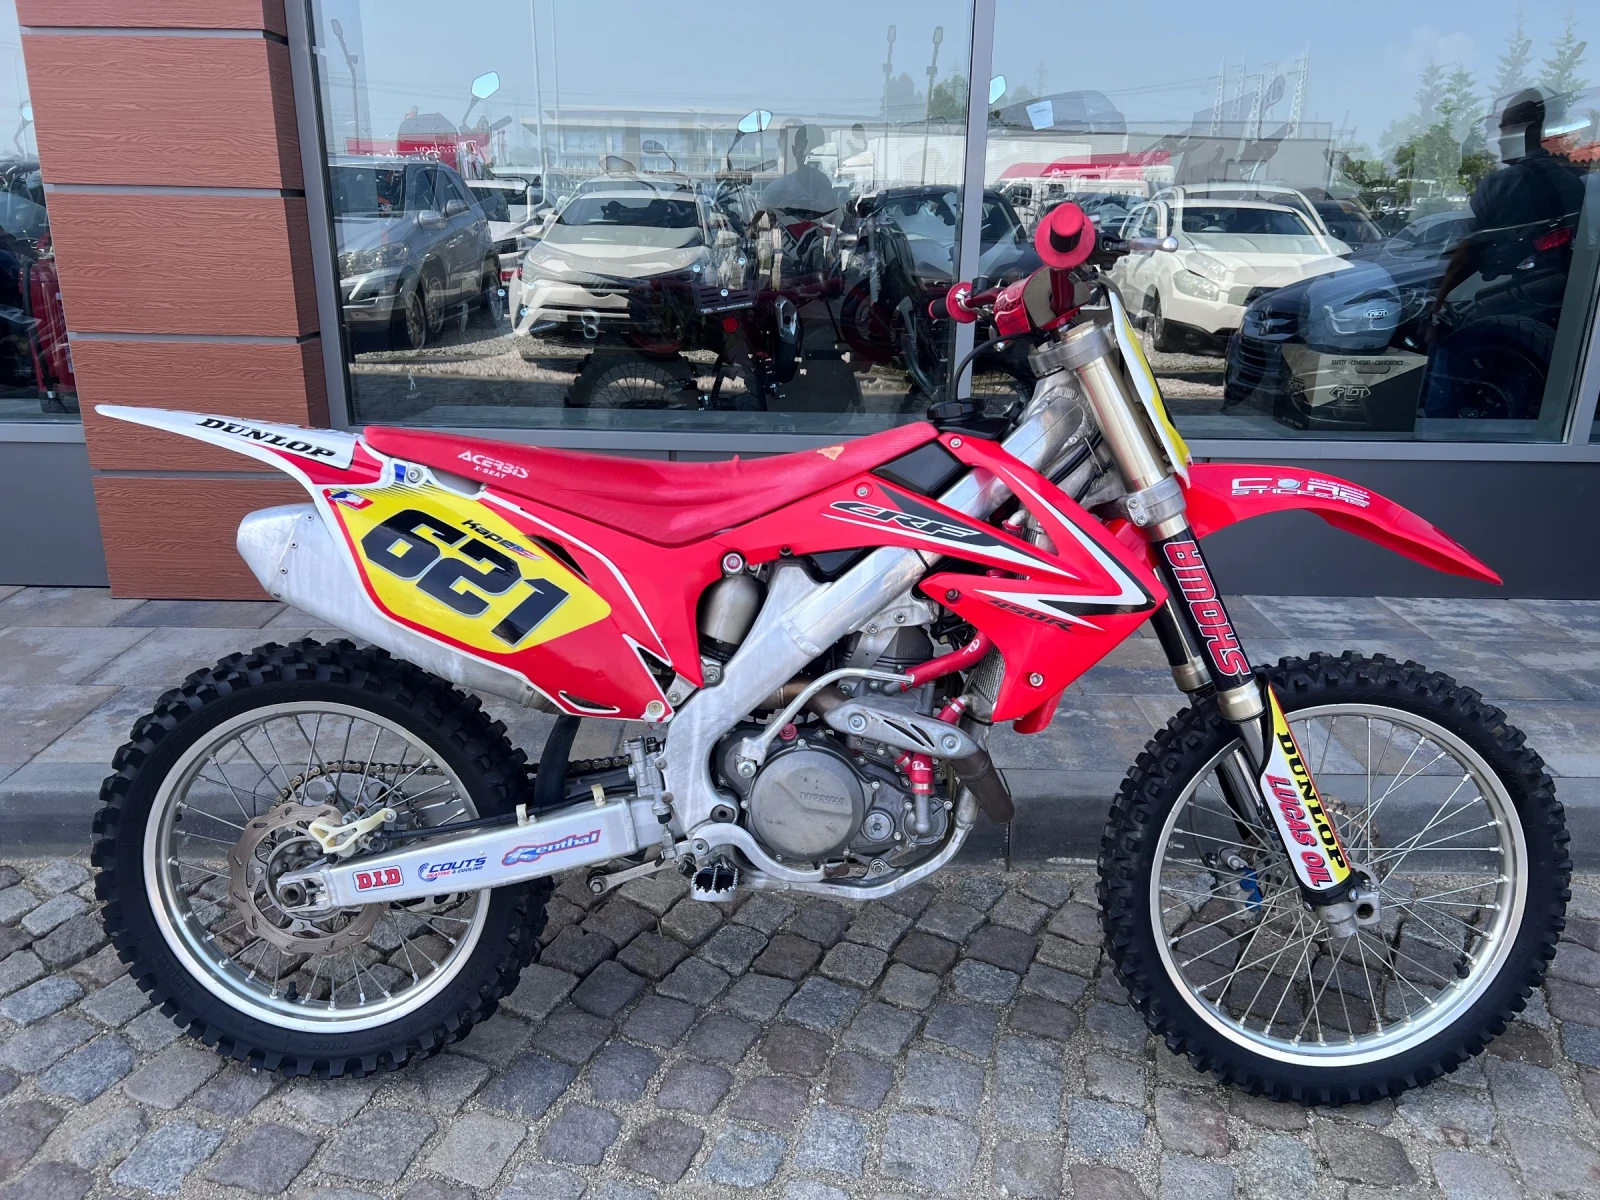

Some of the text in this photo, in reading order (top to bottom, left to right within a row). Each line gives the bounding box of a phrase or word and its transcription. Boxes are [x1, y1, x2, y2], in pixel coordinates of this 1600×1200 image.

[196, 418, 336, 457] DUNLOP
[473, 465, 507, 479] X-SEAT
[829, 500, 983, 537] CRF
[361, 508, 571, 648] 621
[987, 600, 1075, 634] 450R
[1163, 540, 1251, 677] SHOWA
[799, 791, 848, 805] HONDA
[1276, 731, 1346, 869] DUNLOP
[503, 831, 600, 865] Renthal
[1265, 773, 1333, 888] LUCAS OIL
[356, 868, 401, 890] D.I.D
[429, 856, 487, 873] COUTS
